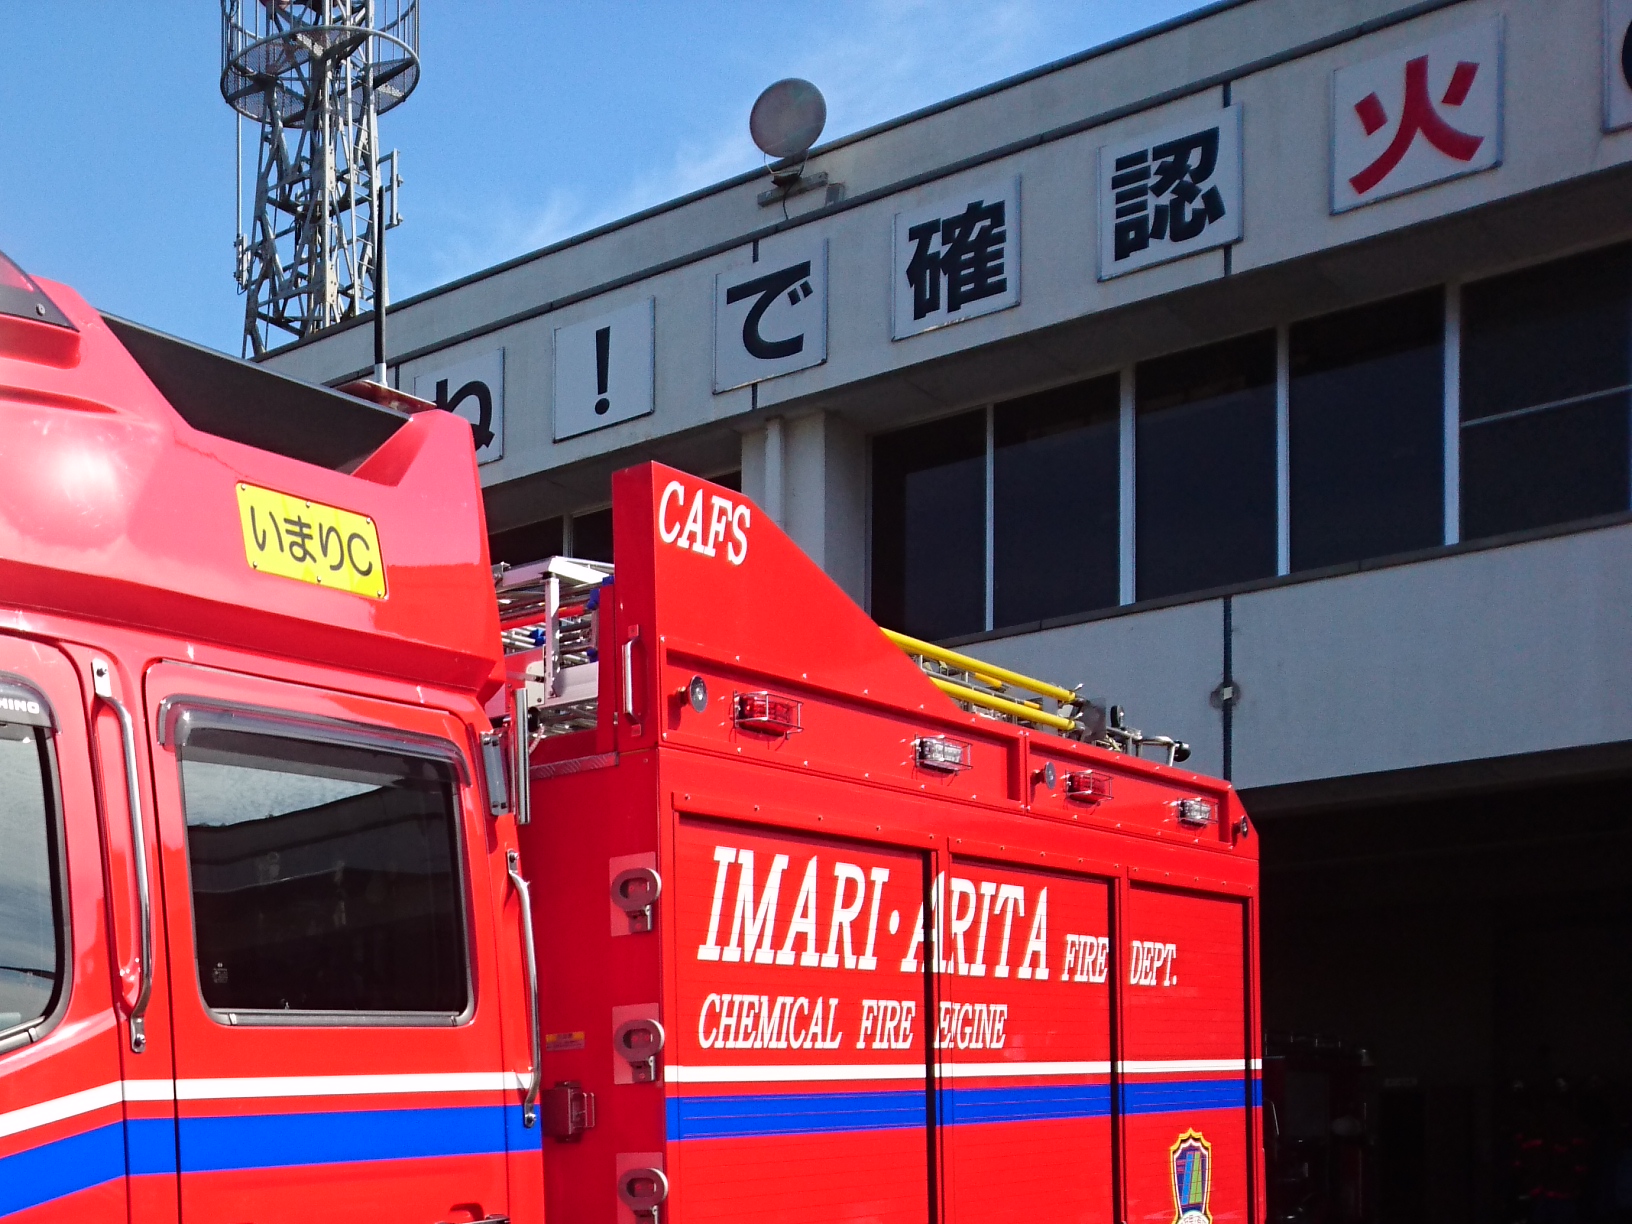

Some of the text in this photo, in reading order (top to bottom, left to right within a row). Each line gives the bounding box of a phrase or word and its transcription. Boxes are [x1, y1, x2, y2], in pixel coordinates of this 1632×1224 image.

[250, 505, 374, 577] いまりC
[658, 480, 751, 566] CAFS
[1061, 933, 1111, 984] FIRE
[1129, 940, 1178, 987] DEPT.
[697, 992, 843, 1050] CHEMICAL
[856, 999, 916, 1050] FIRE
